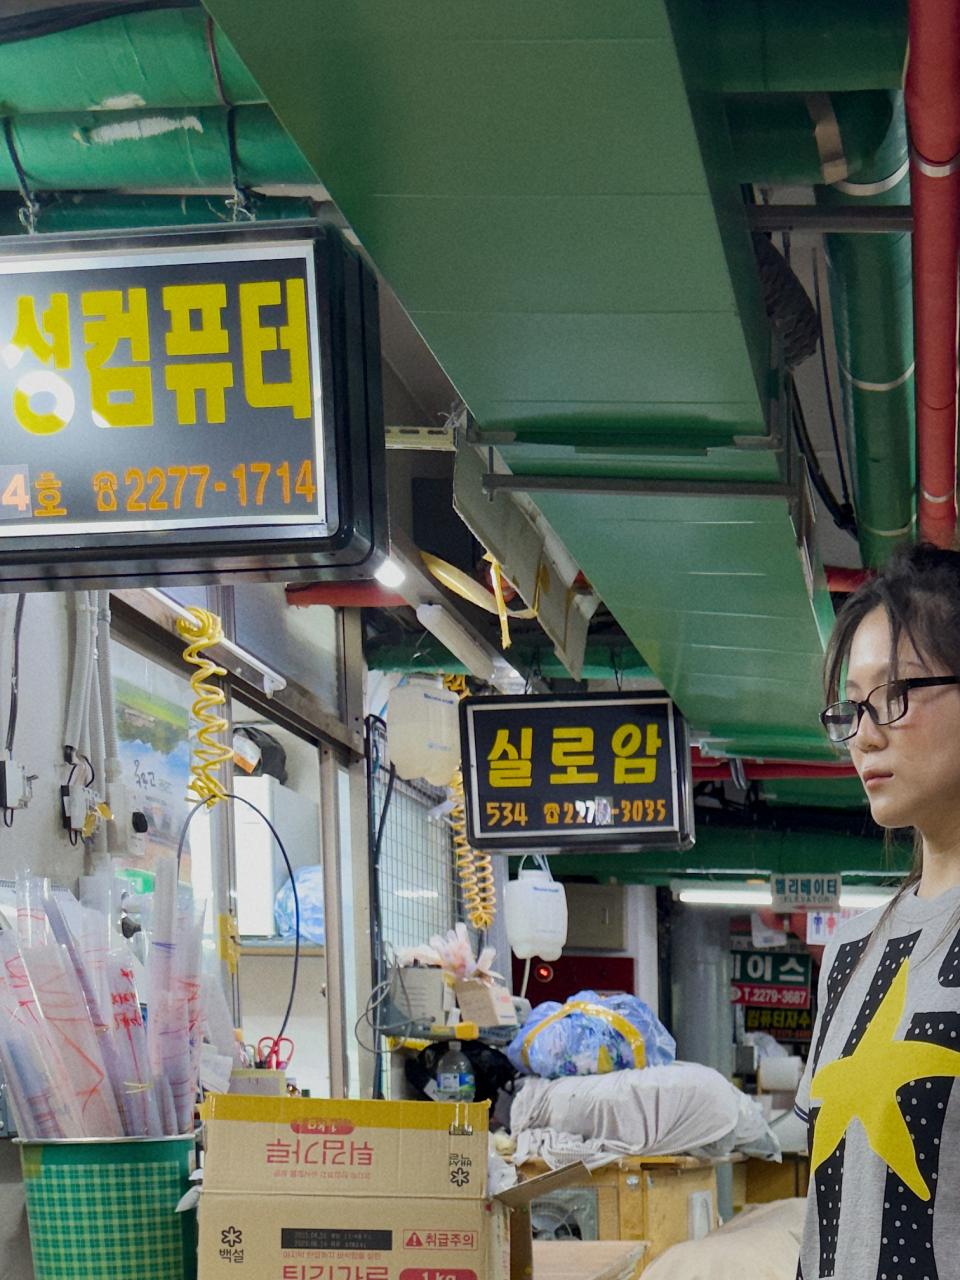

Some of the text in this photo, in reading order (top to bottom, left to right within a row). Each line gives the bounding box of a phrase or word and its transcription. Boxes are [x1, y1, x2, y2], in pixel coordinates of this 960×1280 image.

[7, 278, 312, 436] 성컴퓨터
[124, 459, 316, 512] 2277-1714
[487, 722, 662, 788] 실로암
[486, 802, 529, 826] 534
[266, 1138, 374, 1167] 튀김가루
[426, 1231, 474, 1248] 취급주의
[219, 1248, 244, 1263] 백설
